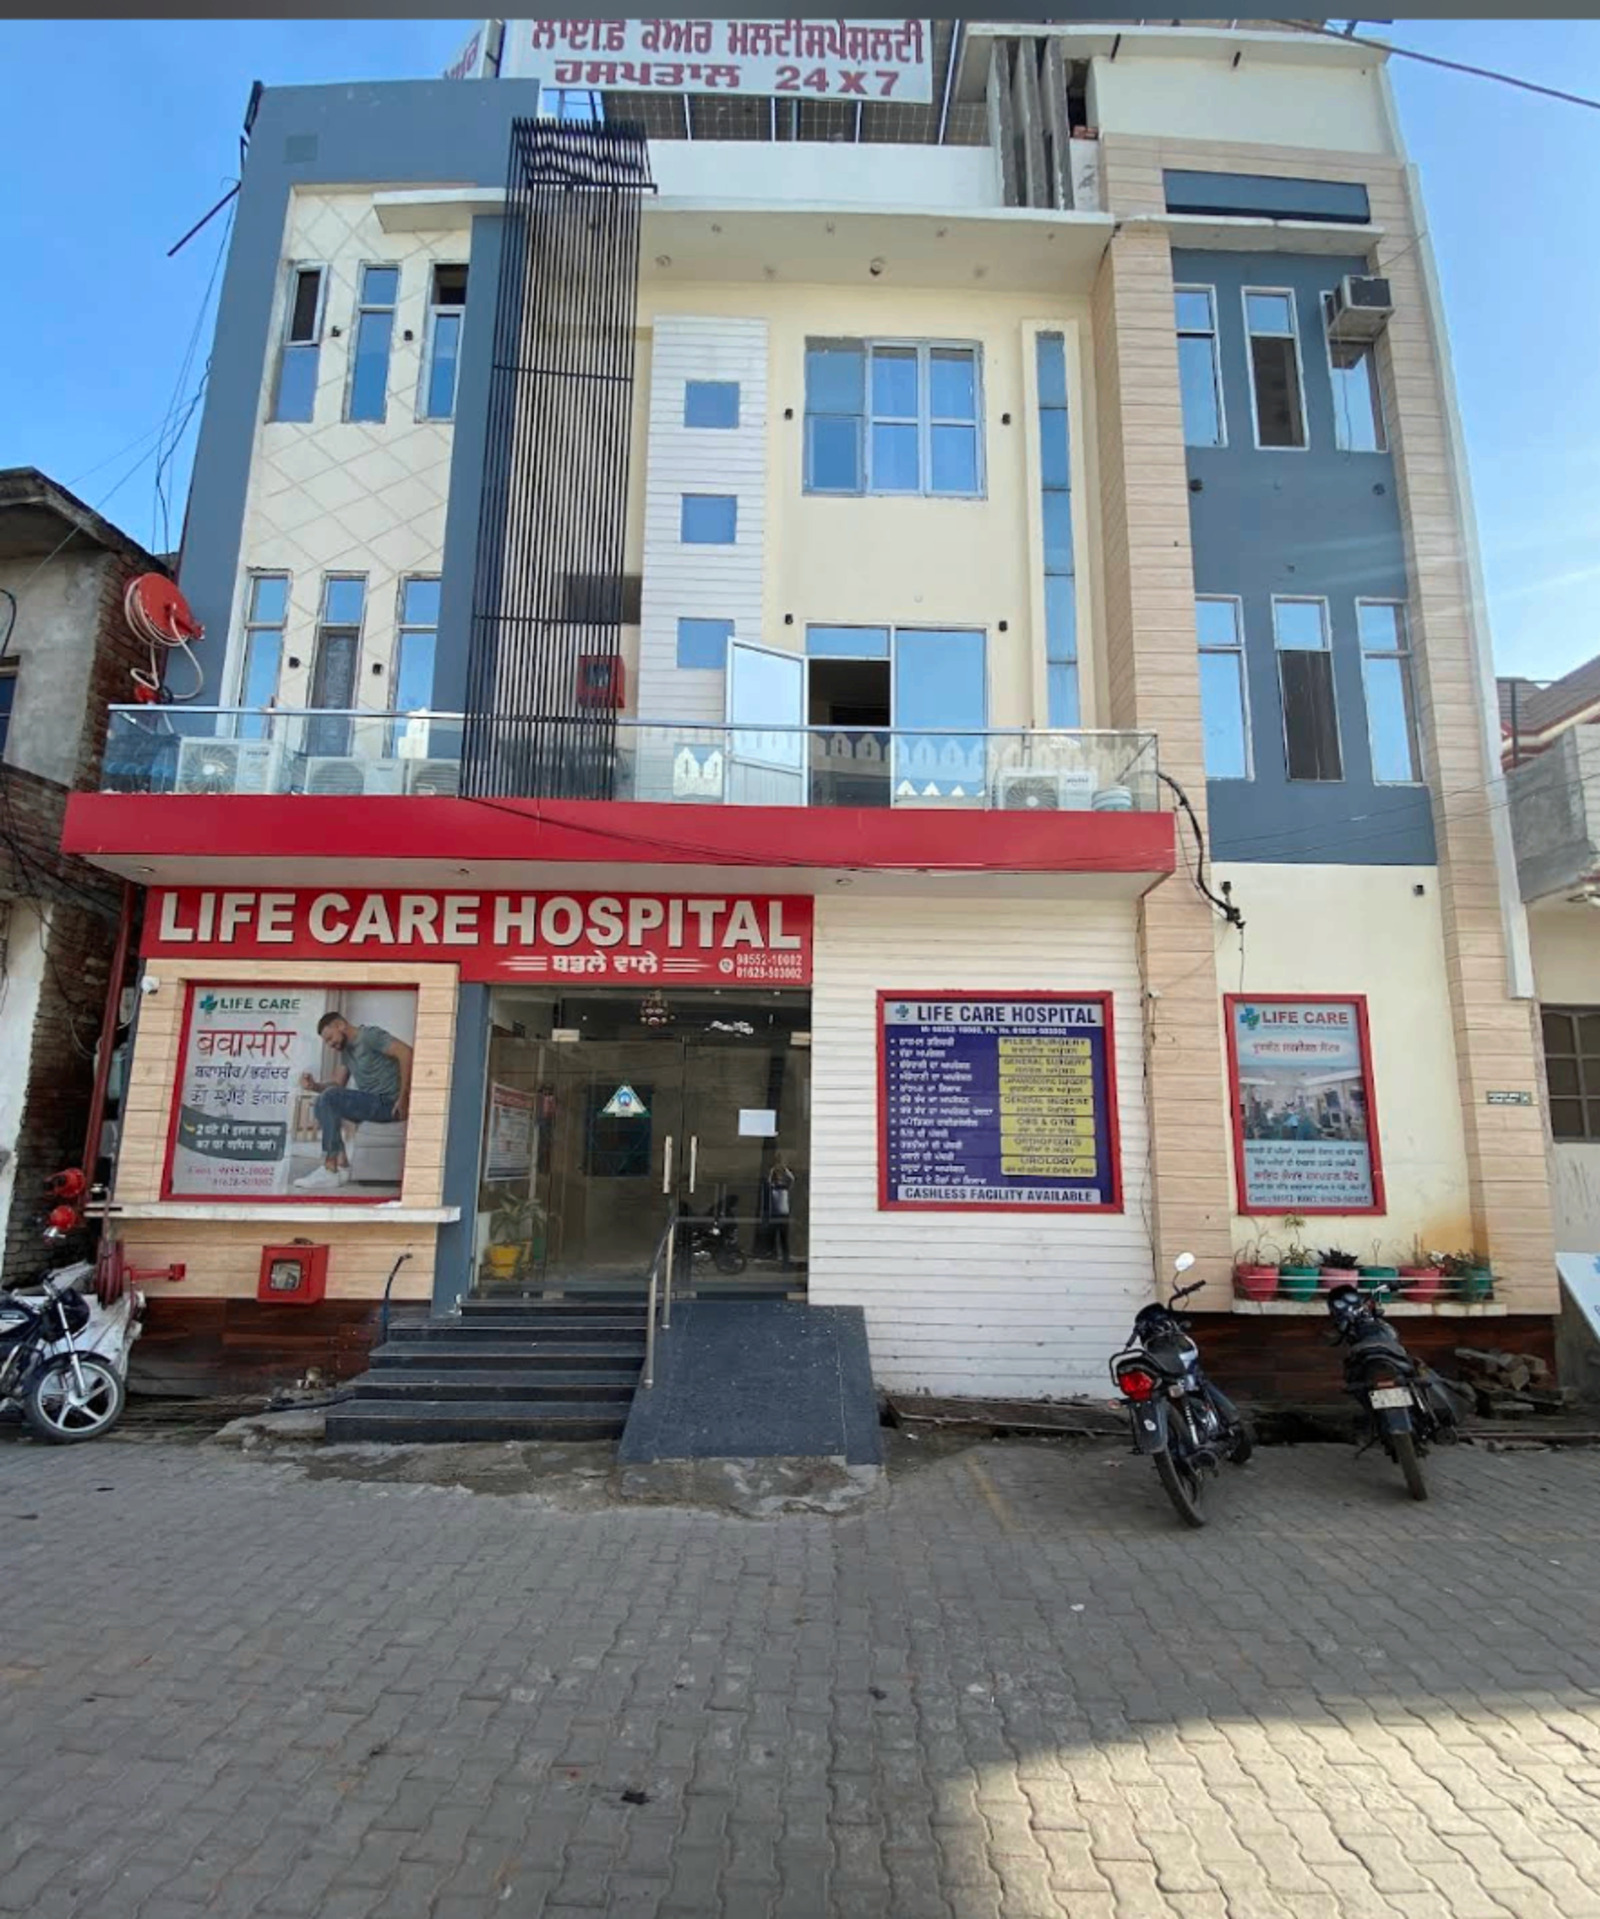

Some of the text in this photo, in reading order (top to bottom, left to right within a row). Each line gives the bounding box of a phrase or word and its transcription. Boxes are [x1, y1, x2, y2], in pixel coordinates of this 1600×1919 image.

[554, 60, 742, 88] ਹਸਪਤਾਲ
[158, 892, 802, 949] LIFE CARE HOSPITAL
[220, 997, 300, 1010] LIFE CARE
[917, 1005, 1097, 1024] LIFE CARE HOSPITAL
[1262, 1011, 1349, 1025] LIFE CARE
[197, 1021, 297, 1059] बवासीर
[1020, 1158, 1077, 1166] UROLOGY
[905, 1188, 1093, 1203] CASHLESS FACILITY AVAILABLE
